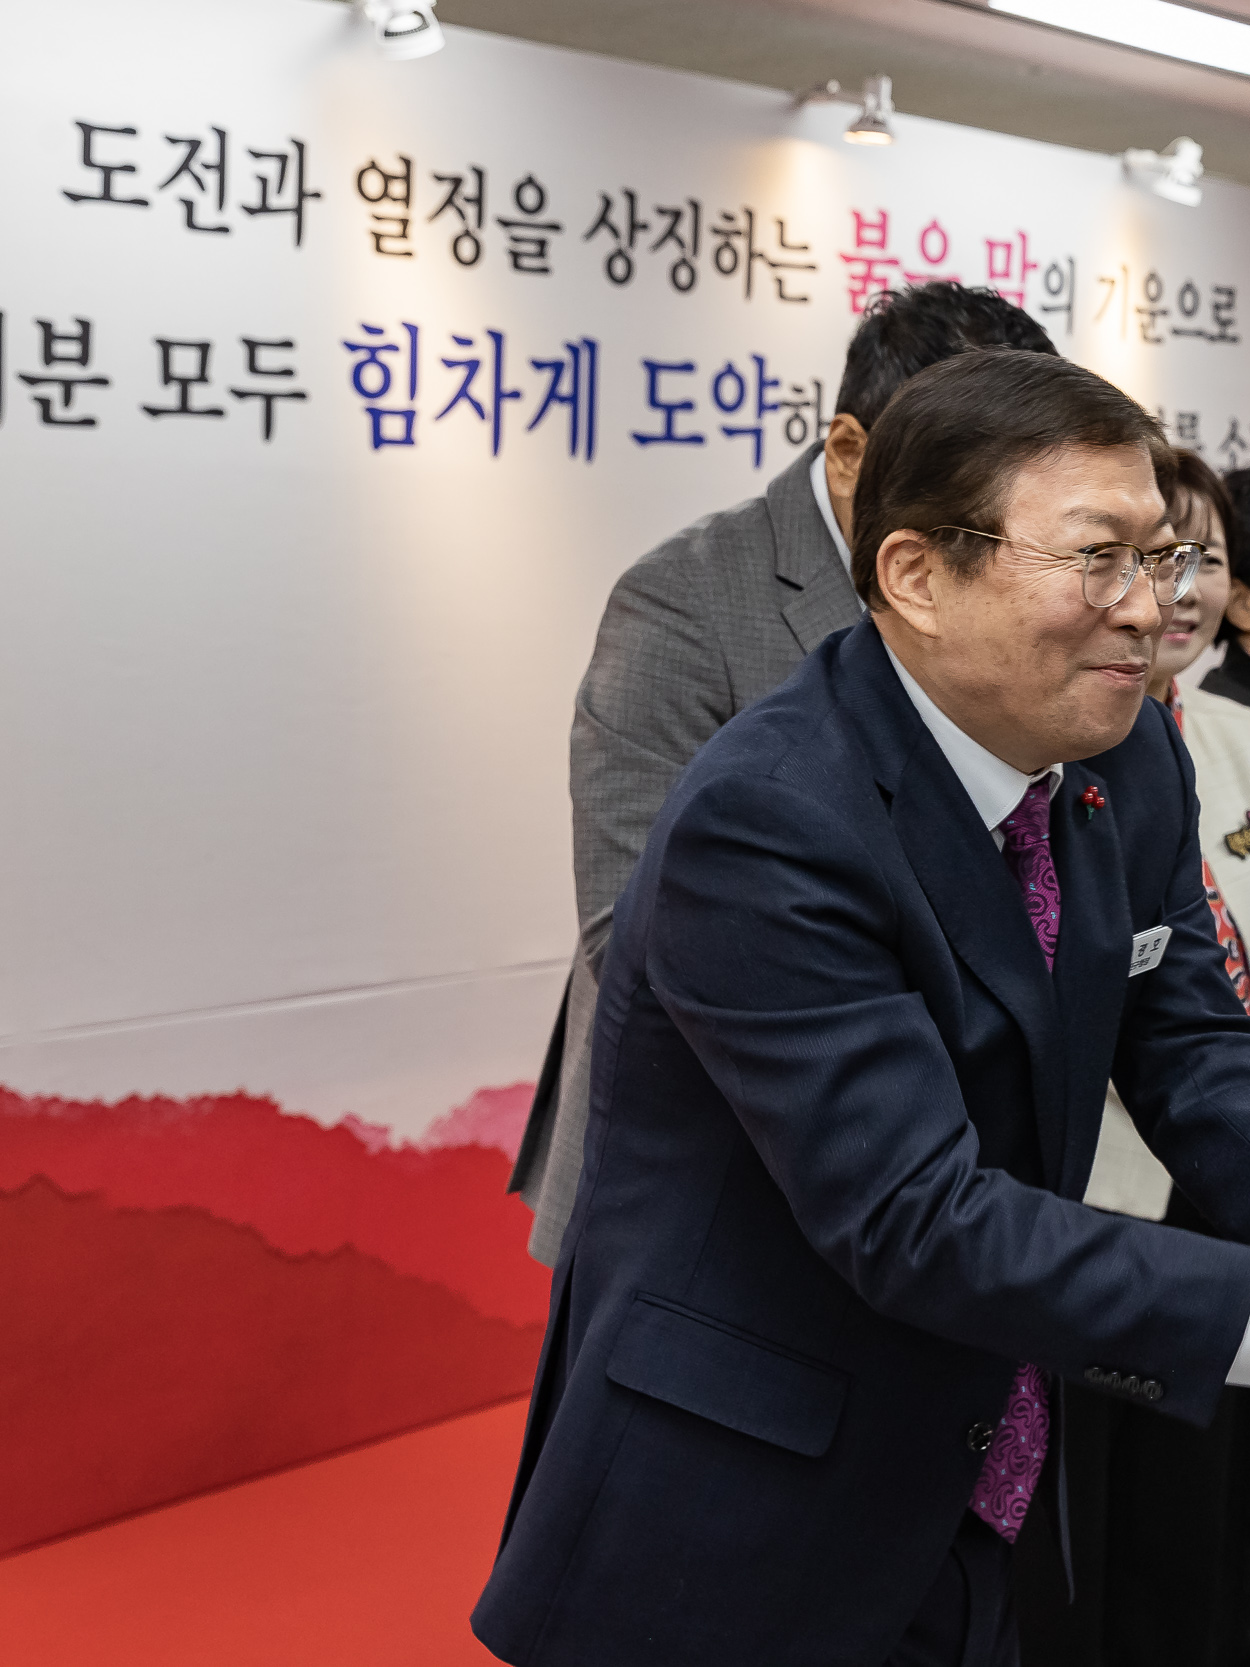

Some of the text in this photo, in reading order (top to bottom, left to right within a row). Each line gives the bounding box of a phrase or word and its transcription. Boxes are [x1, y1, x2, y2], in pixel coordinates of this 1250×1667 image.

[62, 121, 322, 249] 도전과
[354, 154, 564, 275] 열정을
[583, 188, 818, 303] 상징하는
[1093, 264, 1241, 344] 기운으로
[0, 311, 109, 426] 분
[143, 338, 307, 440] 모두
[343, 322, 602, 462] 힘차게
